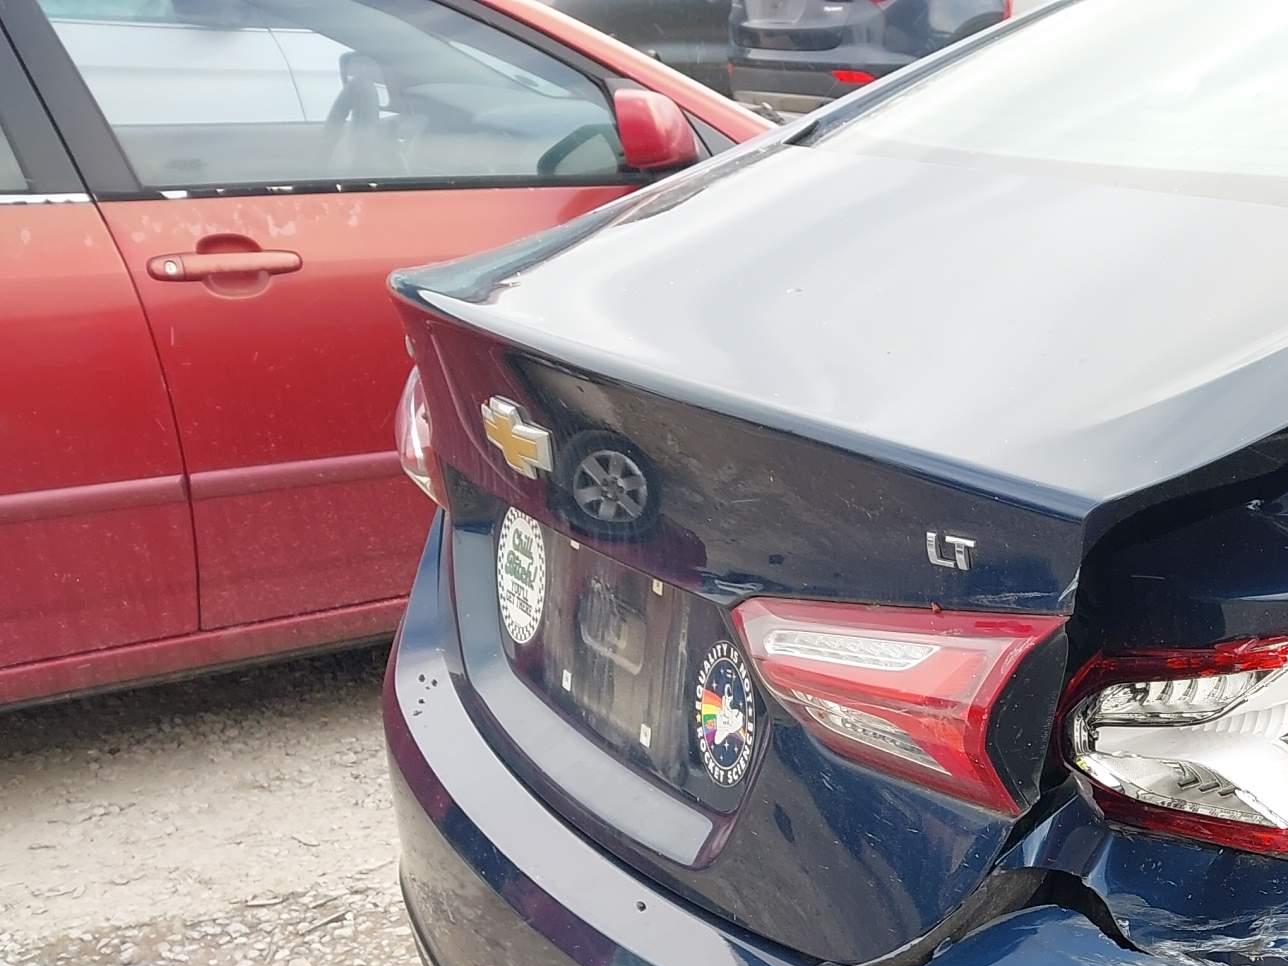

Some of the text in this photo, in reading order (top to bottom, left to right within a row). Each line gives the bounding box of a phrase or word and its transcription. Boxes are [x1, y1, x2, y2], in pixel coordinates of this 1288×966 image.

[512, 528, 532, 559] Chill
[926, 531, 975, 571] LT
[695, 643, 753, 711] EQUALITY IS NOT
[696, 721, 754, 784] ROCKET SCIENCE
